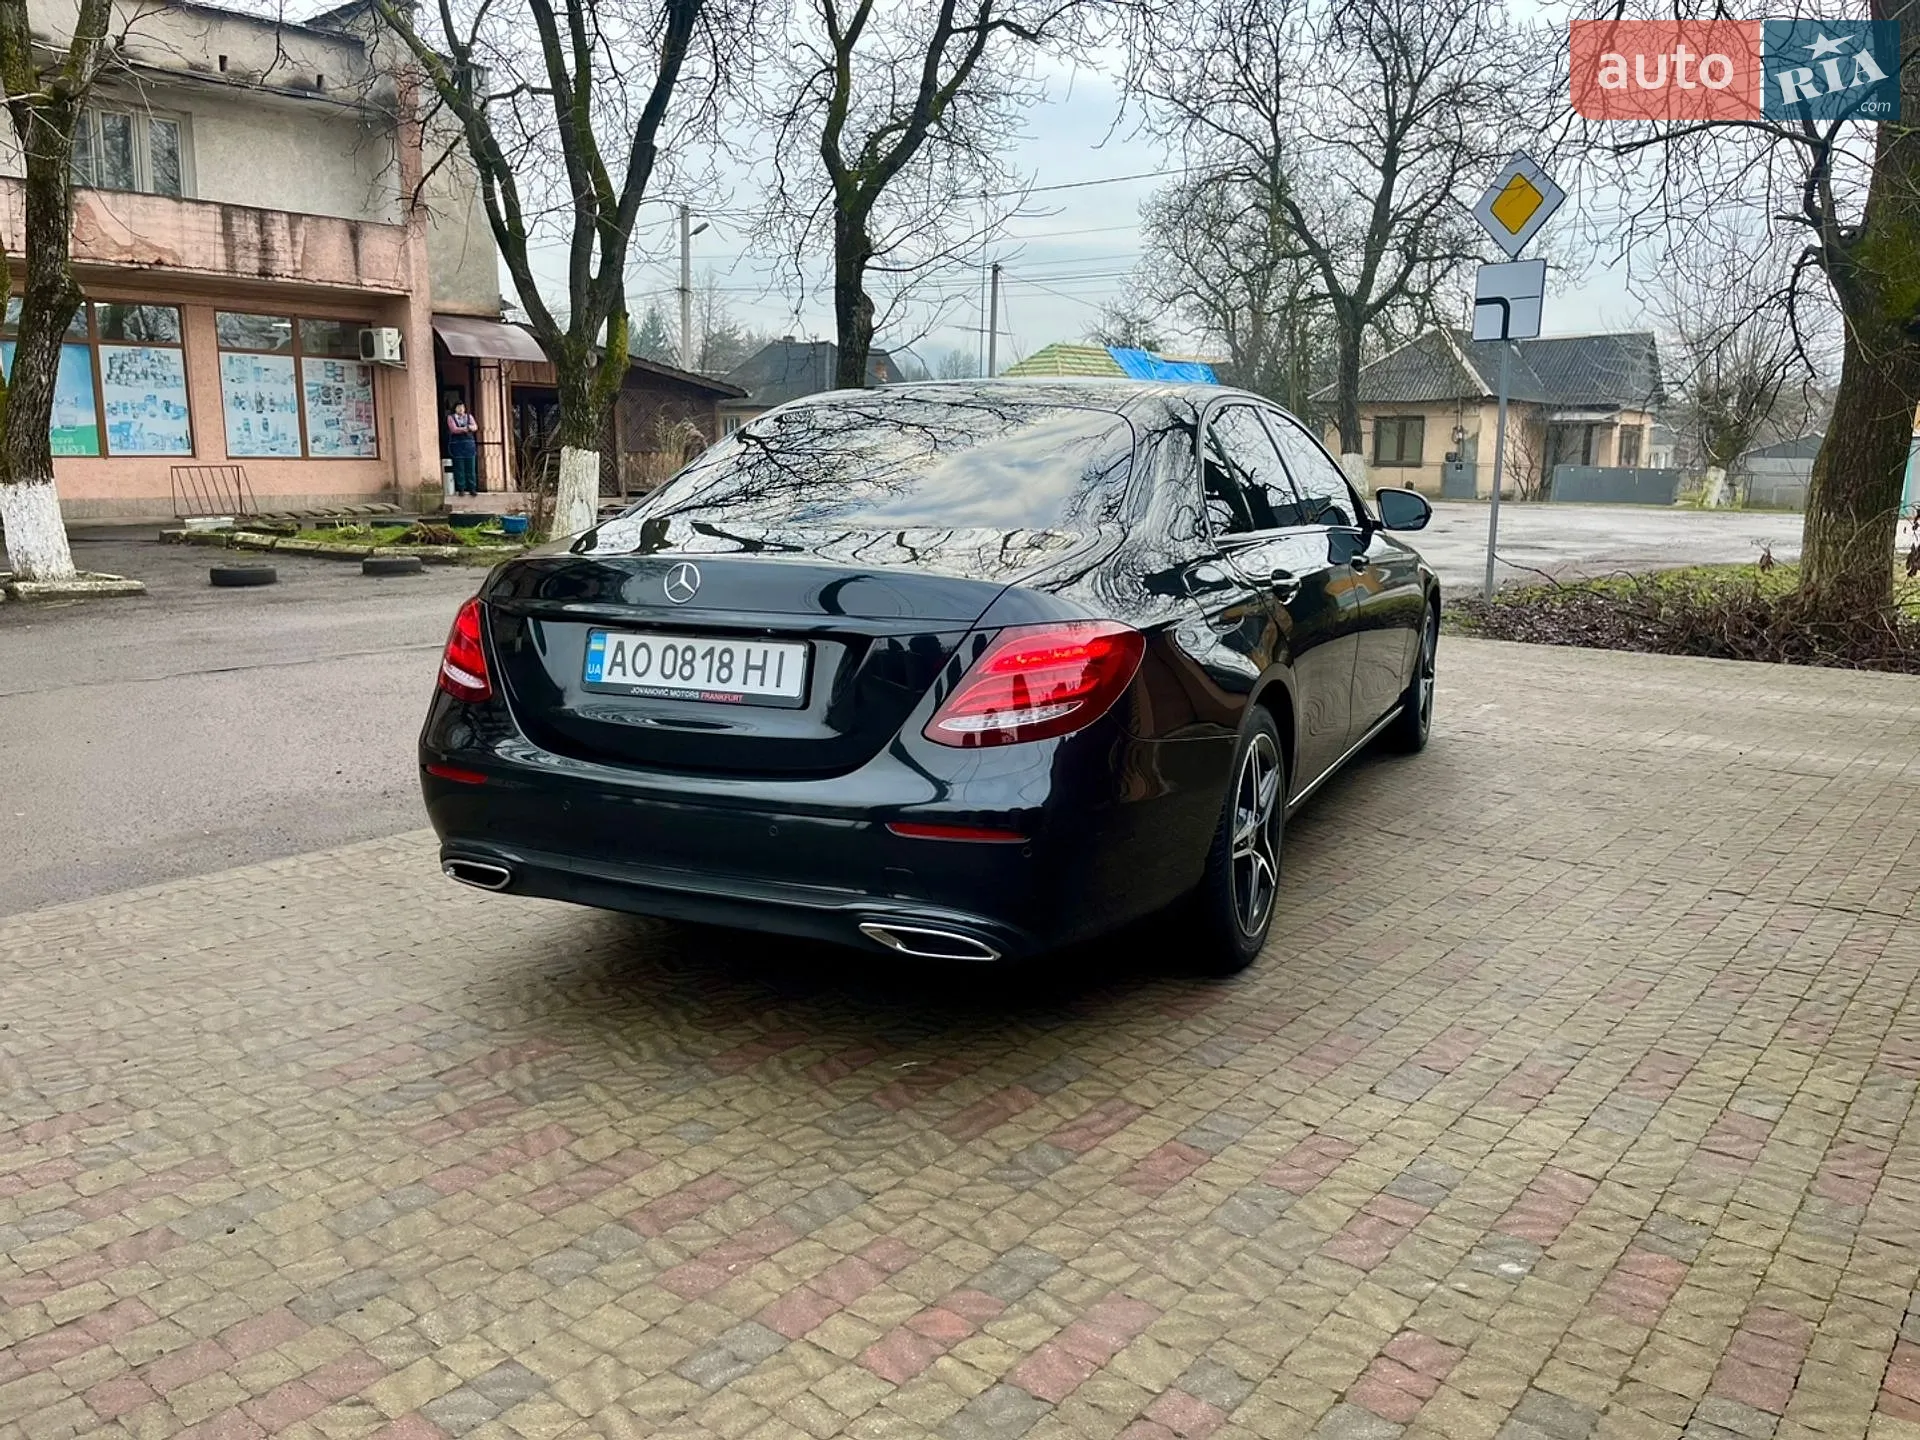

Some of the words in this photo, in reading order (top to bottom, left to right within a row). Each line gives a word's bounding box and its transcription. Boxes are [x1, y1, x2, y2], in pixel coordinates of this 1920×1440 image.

[587, 663, 600, 675] UA
[607, 640, 652, 677] AO
[660, 643, 734, 684] 0818
[742, 648, 784, 688] HI
[669, 689, 699, 699] MOTORS
[701, 691, 743, 703] FRANKFURT
